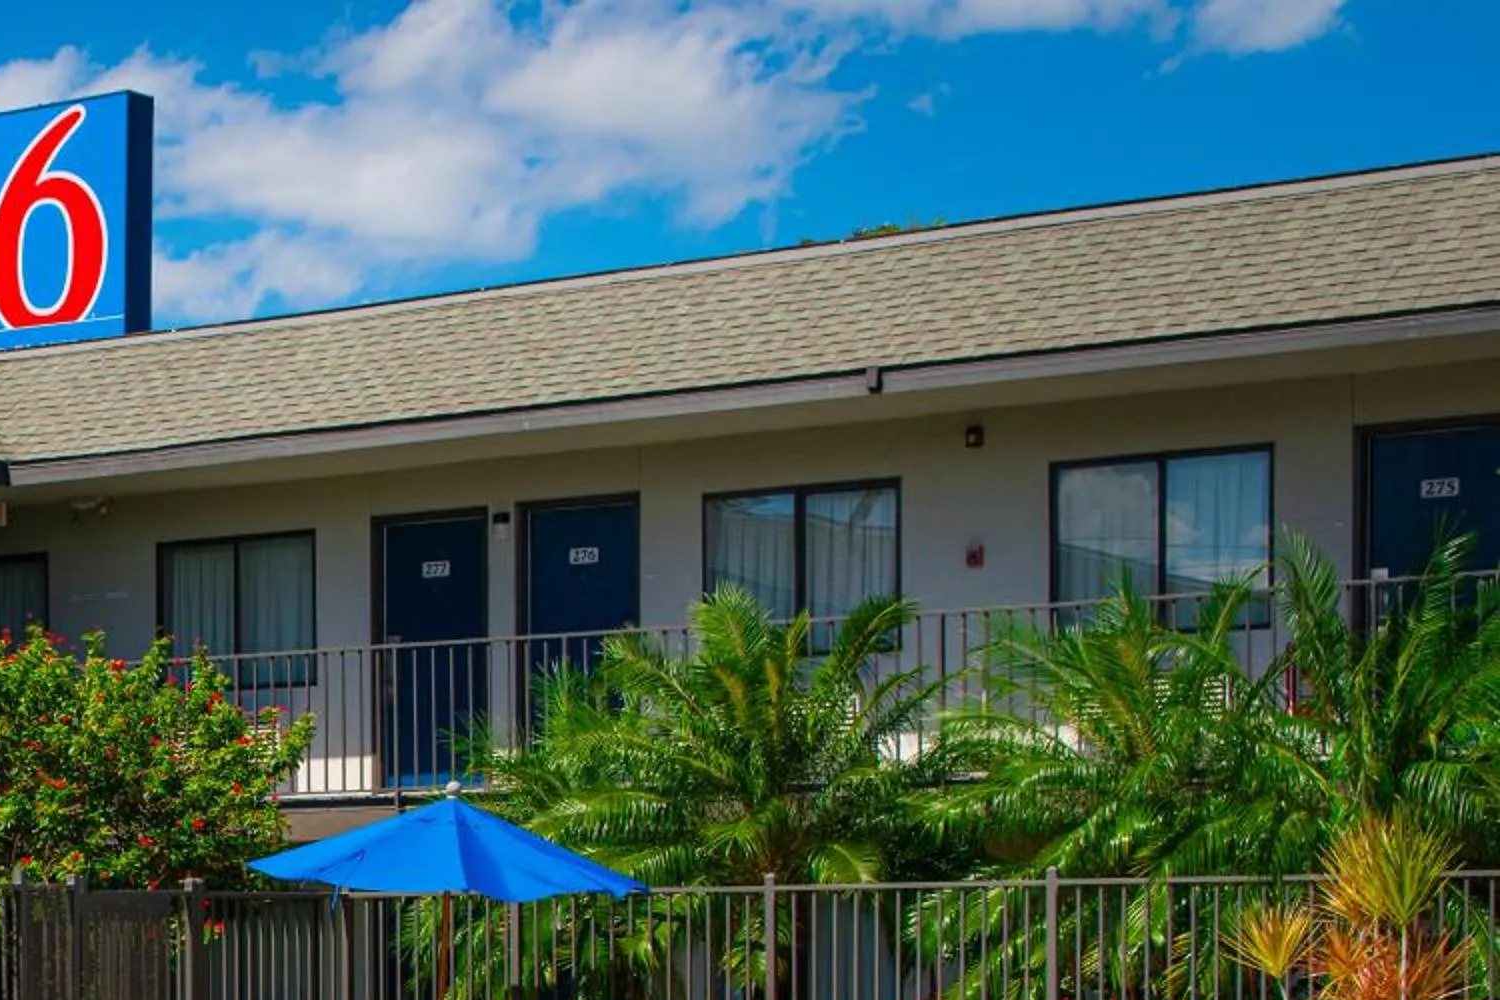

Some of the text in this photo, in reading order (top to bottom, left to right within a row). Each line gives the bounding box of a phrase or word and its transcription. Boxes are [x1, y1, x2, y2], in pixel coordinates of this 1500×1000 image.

[1425, 479, 1456, 497] 275
[572, 548, 597, 564] 276
[425, 561, 448, 576] 277
